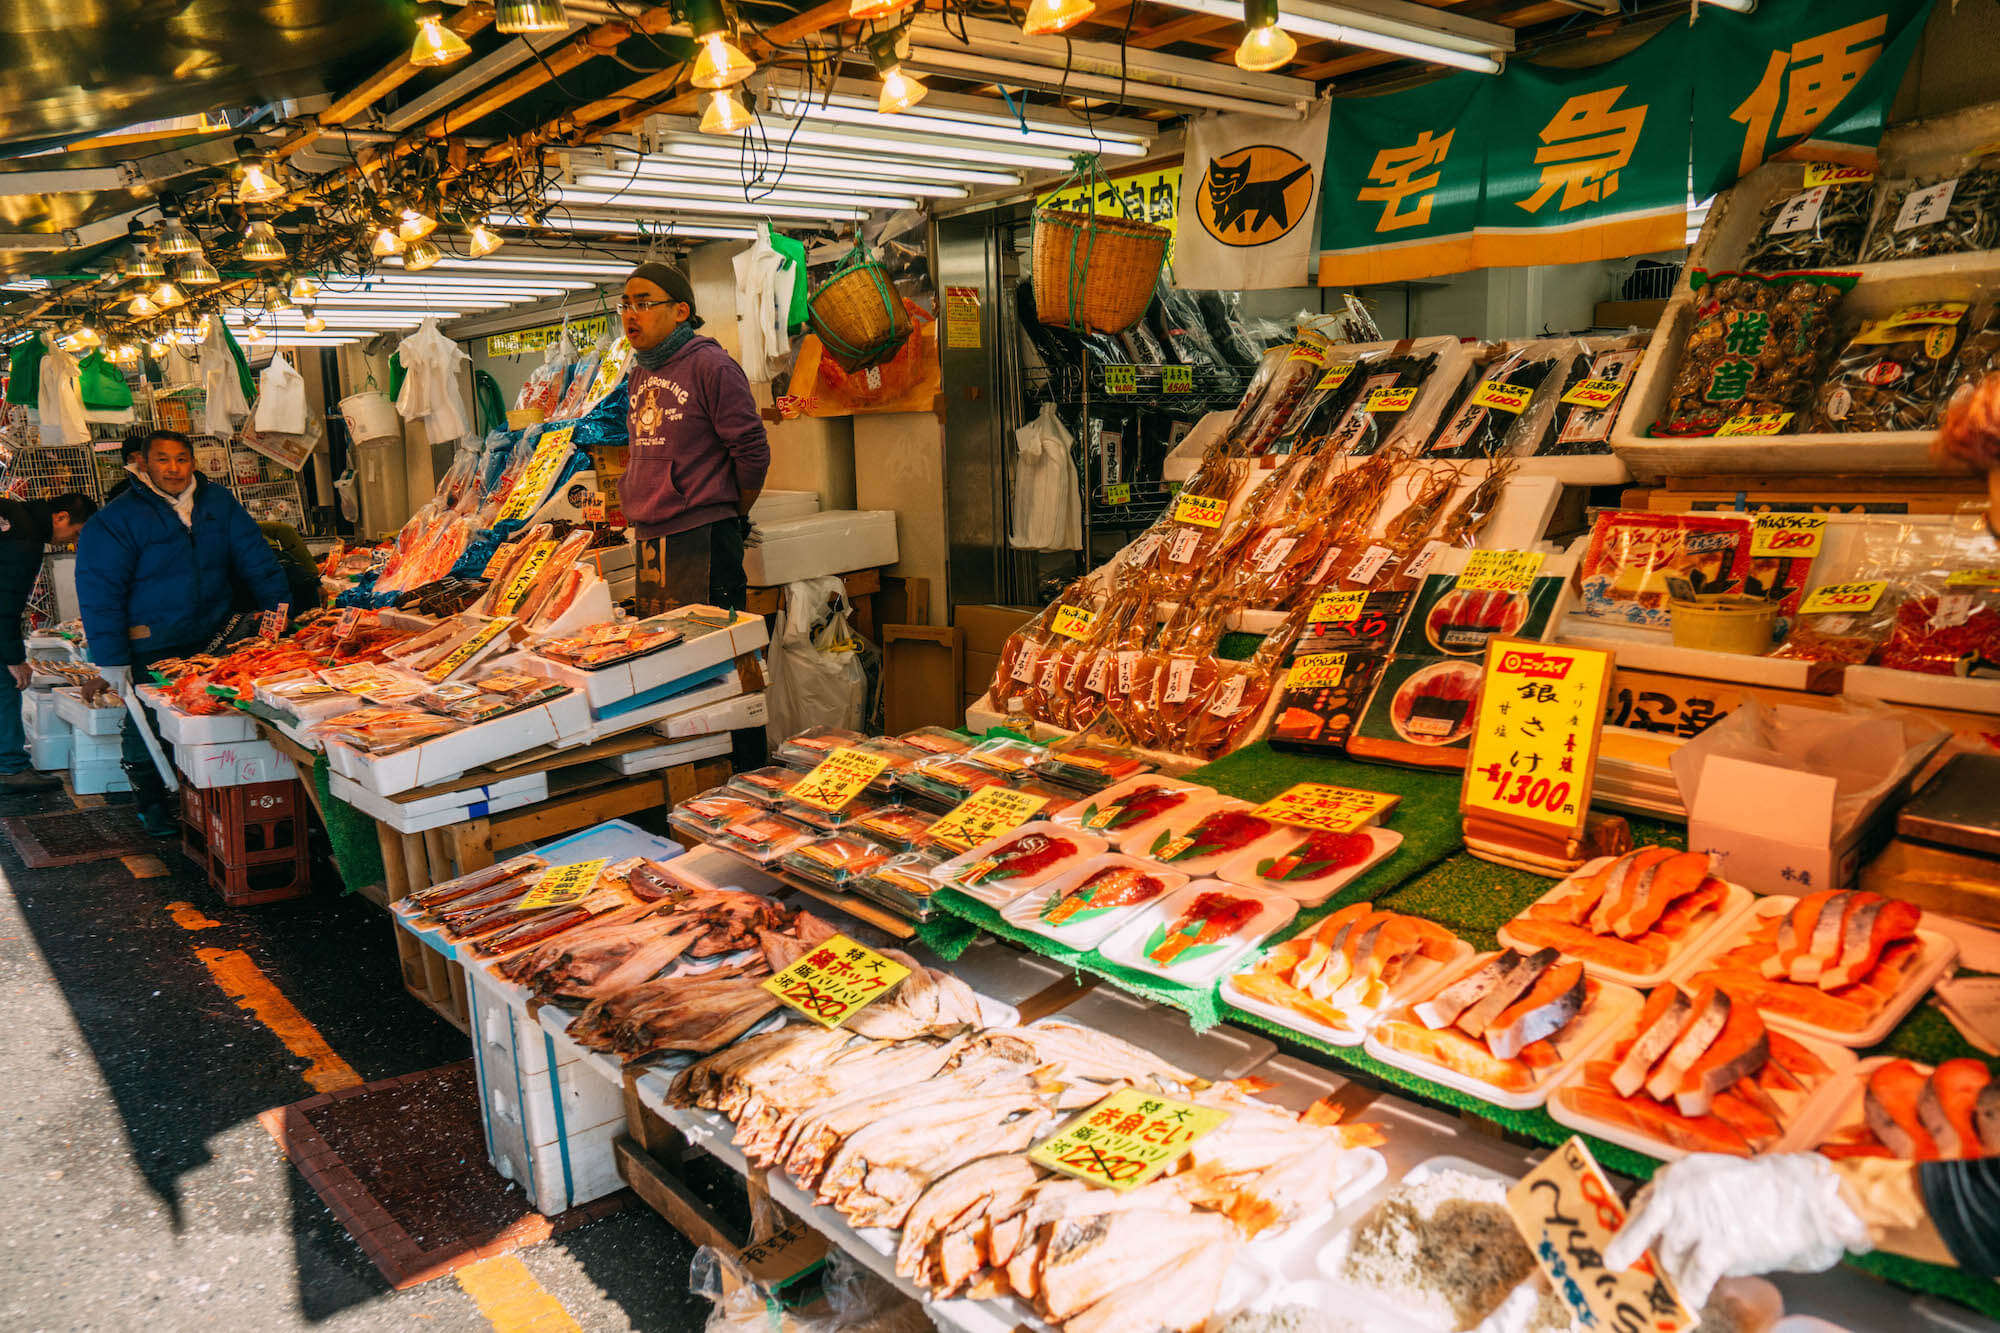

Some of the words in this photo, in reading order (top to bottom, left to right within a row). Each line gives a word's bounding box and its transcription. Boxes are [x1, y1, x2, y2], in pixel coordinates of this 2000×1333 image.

[1357, 15, 1888, 232] 宅急便
[1377, 398, 1409, 407] 500
[1521, 659, 1569, 674] ニッスイ
[1510, 682, 1560, 774] 銀さけ
[845, 947, 887, 973] 特大
[1137, 1100, 1194, 1122] 特大
